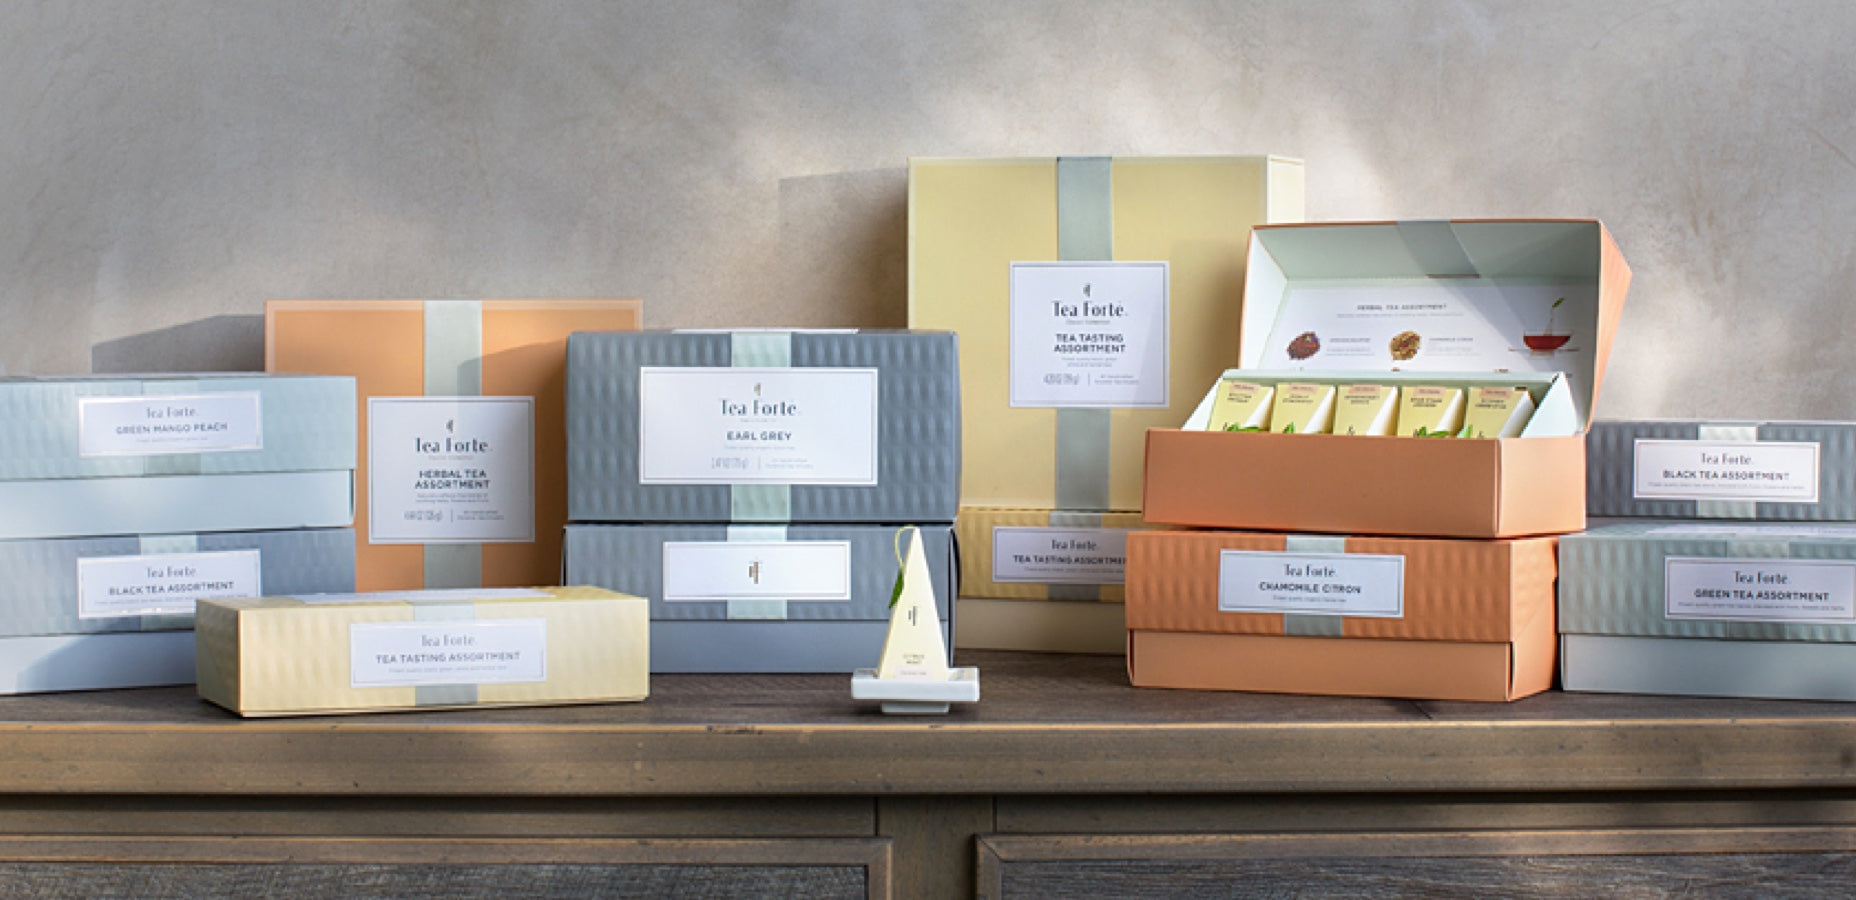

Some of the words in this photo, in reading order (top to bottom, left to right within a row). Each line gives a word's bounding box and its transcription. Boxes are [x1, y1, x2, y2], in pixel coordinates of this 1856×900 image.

[1051, 300, 1078, 317] Tea
[1056, 333, 1077, 343] TEA
[1079, 333, 1124, 343] TASTING
[1054, 344, 1126, 354] ASSORTMENT
[146, 407, 164, 418] Tea
[719, 398, 747, 416] Tea
[115, 424, 151, 435] GREEN
[153, 423, 191, 434] MANGO
[194, 422, 228, 432] PEACH
[726, 431, 757, 441] EARL
[760, 431, 792, 441] GREY
[415, 437, 440, 453] Tea
[1701, 453, 1719, 465] Tea
[419, 469, 462, 479] HERBAL
[464, 469, 487, 479] TEA
[1662, 470, 1697, 479] BLACK
[1699, 471, 1719, 480] TEA
[1721, 471, 1790, 481] ASSORTMENT
[415, 480, 491, 490] ASSORTMENT
[1051, 539, 1068, 550] Tea
[1013, 555, 1031, 564] TEA
[1033, 555, 1073, 564] TASTING
[147, 568, 164, 579] Tea
[1284, 564, 1301, 577] Tea
[1734, 571, 1754, 584] Tea
[109, 587, 143, 596] BLACK
[145, 585, 165, 595] TEA
[167, 581, 235, 594] ASSORTMENT
[1258, 582, 1319, 594] CHAMOMILE
[1322, 584, 1361, 595] CITRON
[1694, 589, 1730, 599] GREEN
[1732, 590, 1753, 600] TEA
[1756, 591, 1830, 601] ASSORTMENT
[421, 635, 440, 647] Tea
[376, 654, 397, 664] TEA
[401, 653, 446, 664] TASTING
[448, 652, 521, 663] ASSORTMENT
